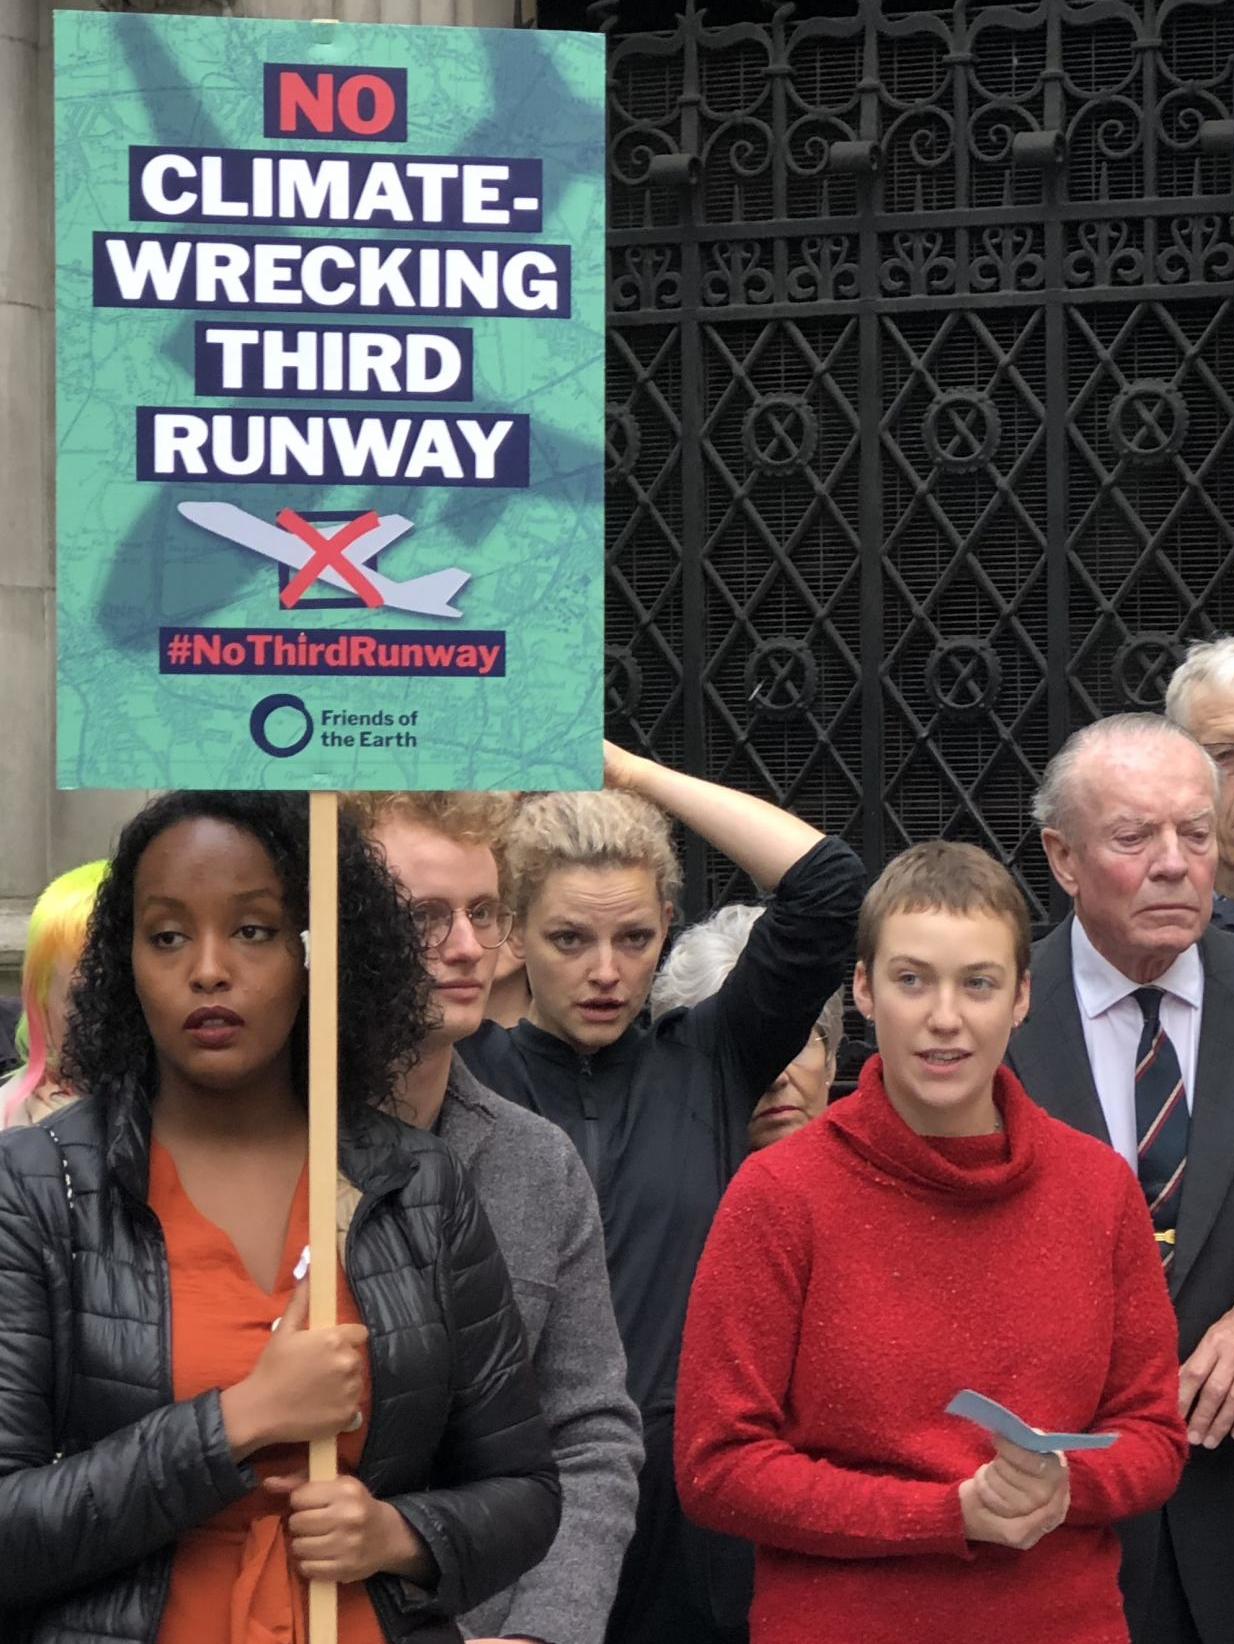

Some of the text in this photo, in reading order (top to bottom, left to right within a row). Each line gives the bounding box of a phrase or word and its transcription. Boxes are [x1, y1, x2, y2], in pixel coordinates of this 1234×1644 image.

[279, 71, 395, 135] NO
[141, 154, 539, 226] CLIMATE-
[104, 239, 559, 311] WRECKING
[205, 329, 462, 393] THIRD
[153, 413, 514, 479] RUNWAY
[167, 632, 500, 675] #NoThirdRunway
[321, 709, 418, 728] Friends of
[321, 731, 417, 748] the Earth
